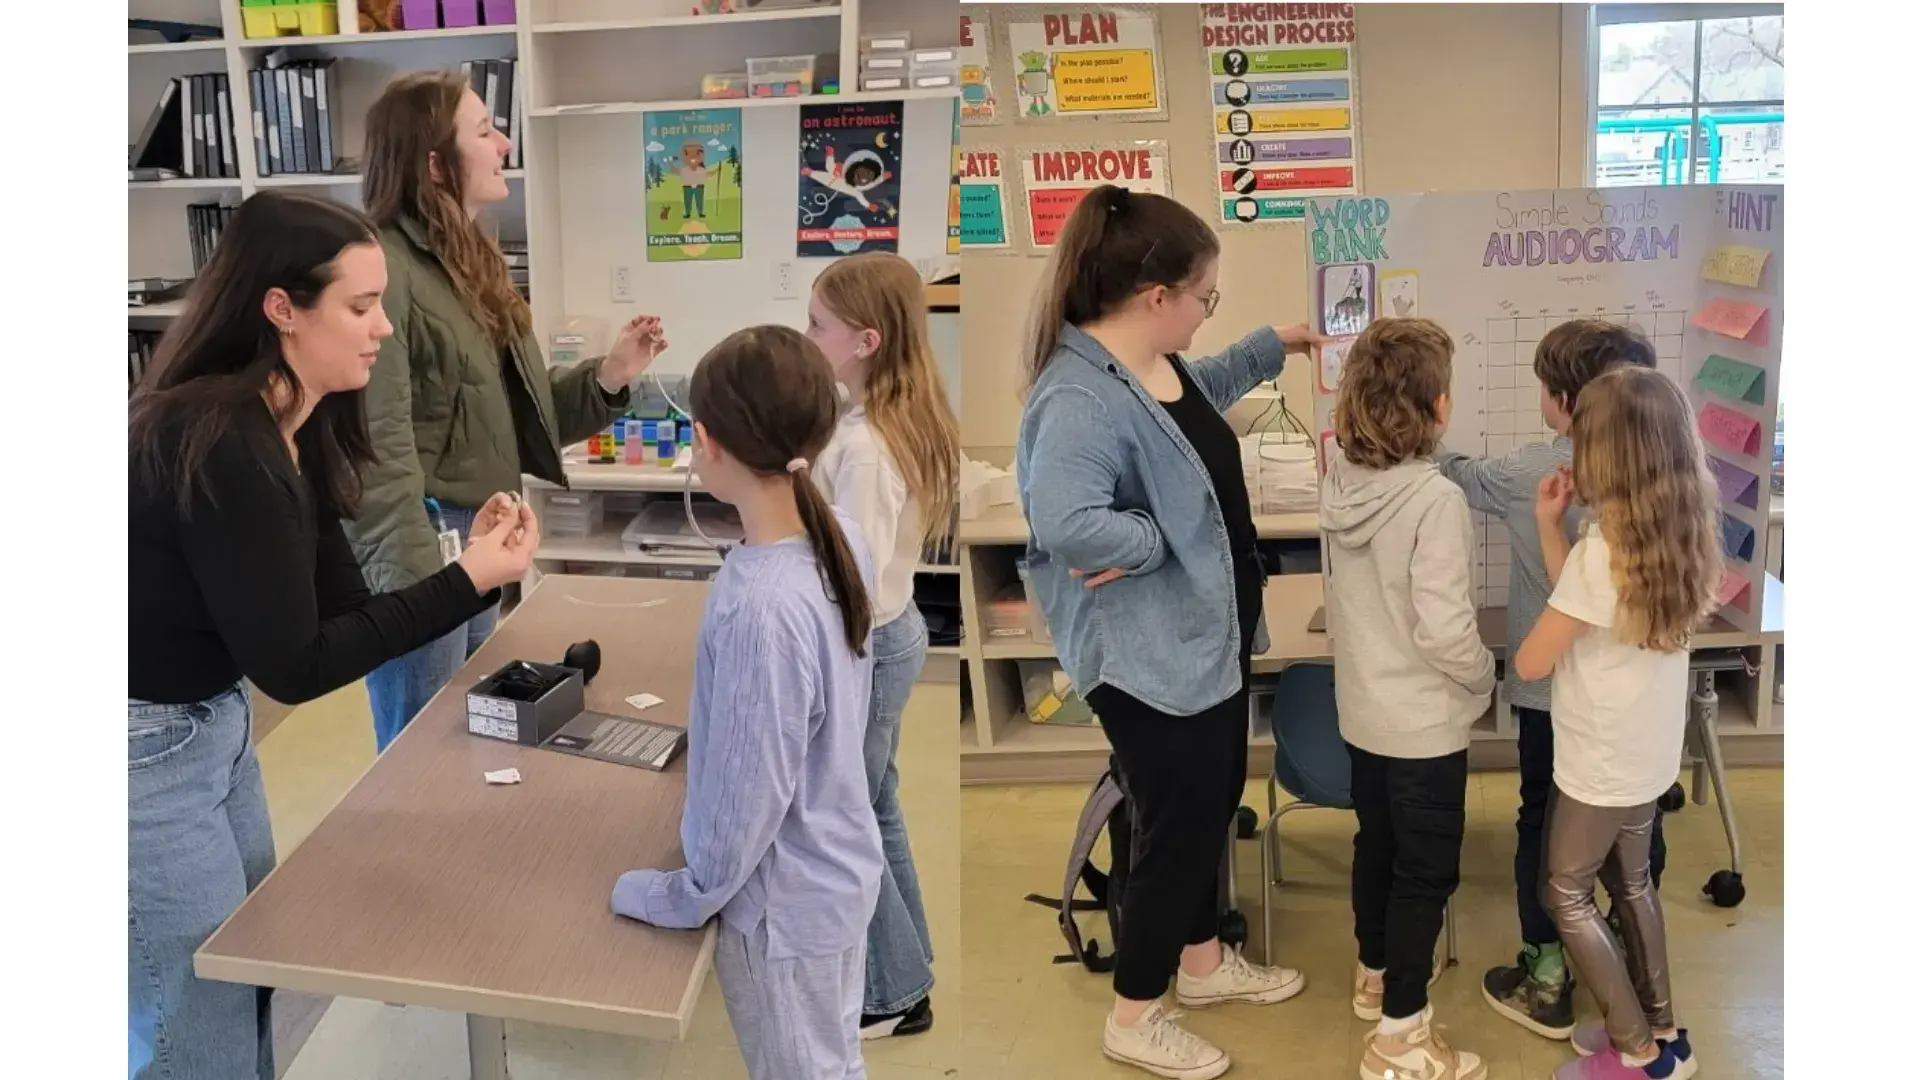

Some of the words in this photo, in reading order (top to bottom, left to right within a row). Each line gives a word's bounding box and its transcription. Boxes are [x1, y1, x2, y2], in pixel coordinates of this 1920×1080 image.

[1044, 12, 1118, 45] PLAN
[1228, 3, 1354, 23] ENGINEERING
[1202, 25, 1268, 47] DESIGN
[1274, 21, 1355, 44] PROCESS
[662, 123, 688, 139] park
[803, 118, 820, 128] an
[1032, 150, 1152, 181] IMPROVE
[1263, 171, 1295, 180] IMPROVE
[1310, 198, 1389, 229] WORD
[1496, 190, 1569, 229] Simple
[1580, 189, 1660, 226] Sounds
[1728, 190, 1777, 231] HINT
[1312, 228, 1389, 264] BANK
[1482, 223, 1680, 268] AUDIOGRAM
